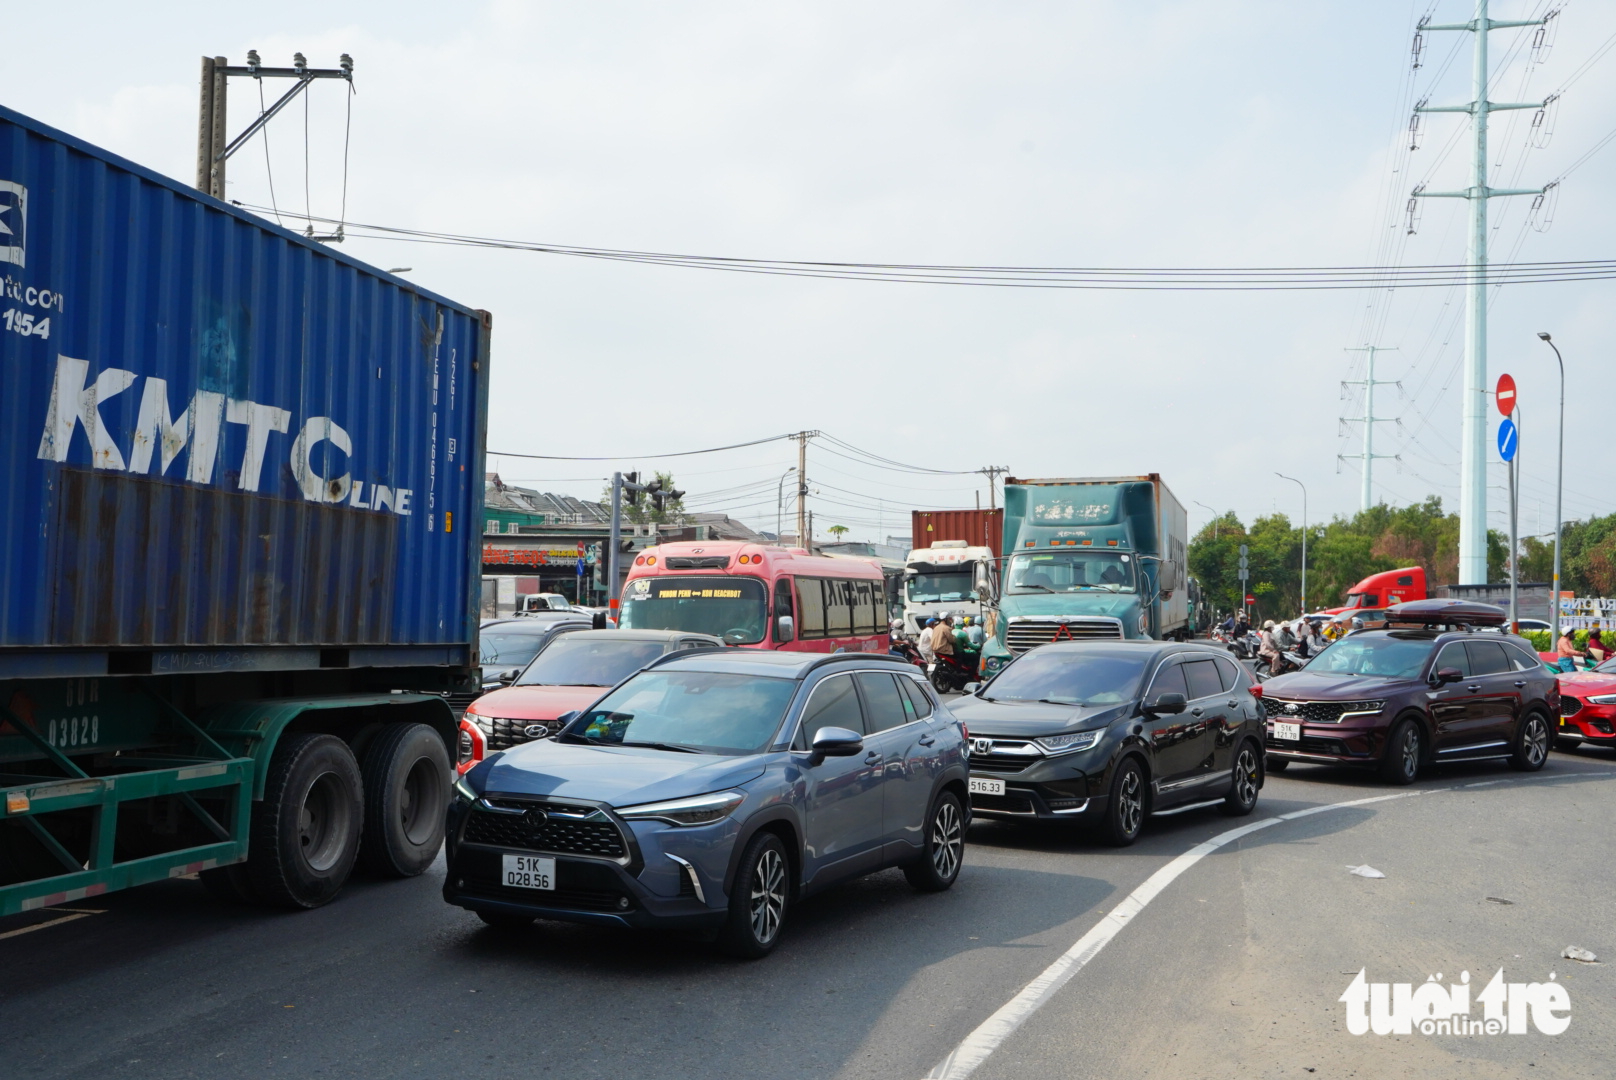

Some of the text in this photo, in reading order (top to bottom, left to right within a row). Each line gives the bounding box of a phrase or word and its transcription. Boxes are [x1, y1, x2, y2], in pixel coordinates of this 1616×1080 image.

[3, 308, 51, 339] 1954
[36, 353, 413, 516] KMTC LINE
[48, 715, 99, 747] 03828
[970, 781, 1001, 793] 516.33
[517, 857, 540, 872] 51K
[508, 871, 549, 888] 028.56
